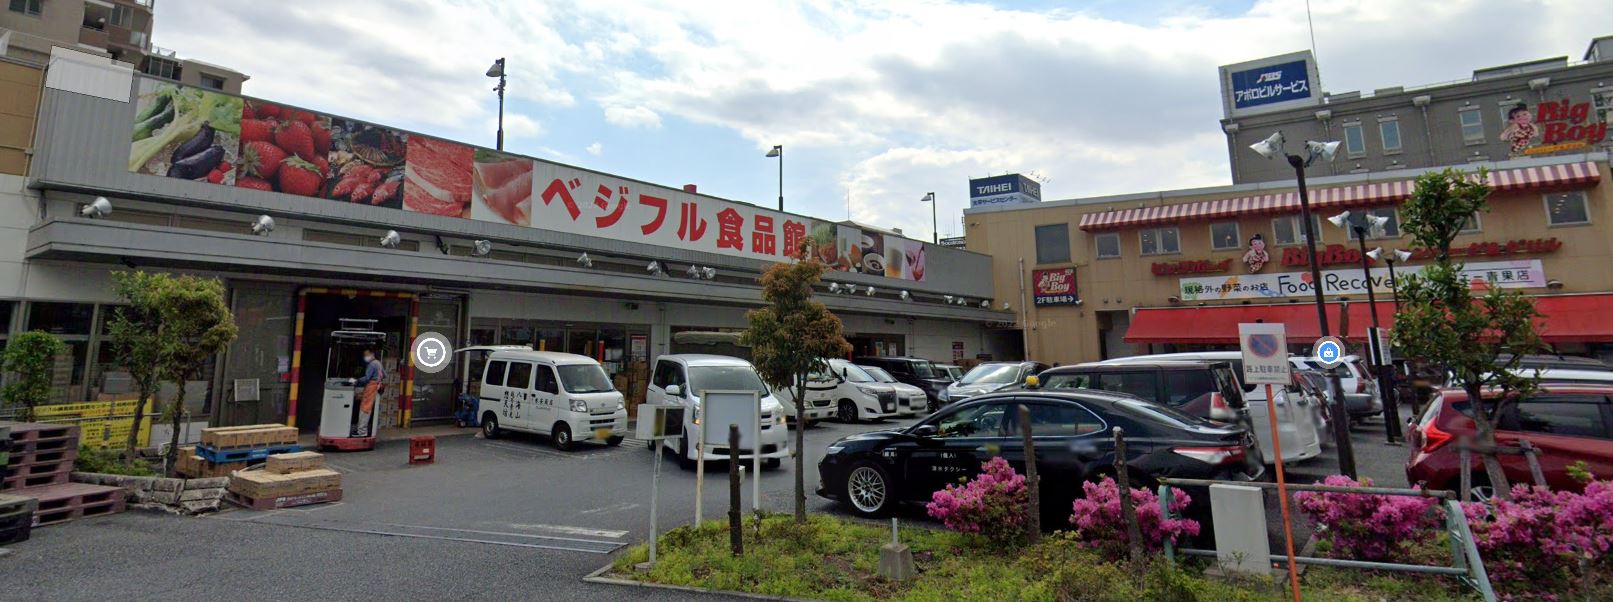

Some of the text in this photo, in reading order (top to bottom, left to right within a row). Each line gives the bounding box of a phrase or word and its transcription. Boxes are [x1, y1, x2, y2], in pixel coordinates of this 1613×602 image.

[1235, 80, 1308, 102] アポロビルサービス
[1536, 97, 1591, 125] Big
[1542, 121, 1608, 145] Boy
[976, 182, 1012, 194] TAIHEI
[541, 178, 807, 257] ベジフル食品館
[1281, 244, 1376, 268] BiBo
[1049, 272, 1066, 284] Big
[1051, 281, 1070, 292] Boy
[1184, 283, 1269, 294] 規格外の野菜のお店
[1325, 273, 1395, 292] Recove
[1036, 296, 1068, 304] 2F駐車場
[1246, 365, 1288, 374] 路上駐車禁止
